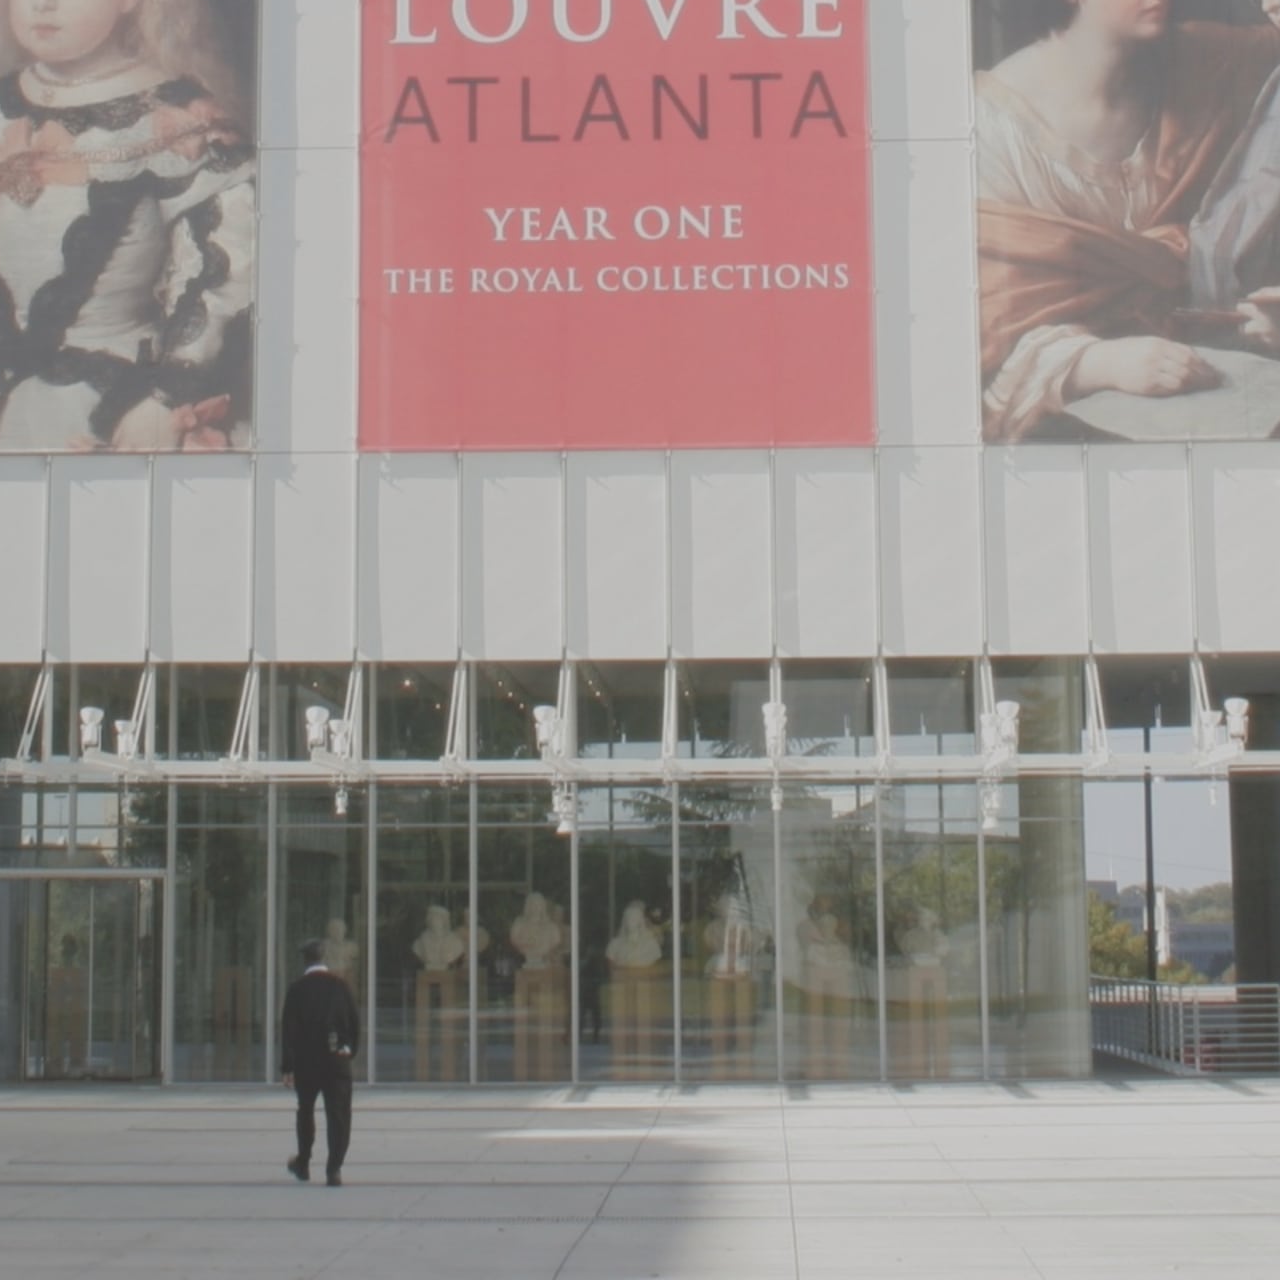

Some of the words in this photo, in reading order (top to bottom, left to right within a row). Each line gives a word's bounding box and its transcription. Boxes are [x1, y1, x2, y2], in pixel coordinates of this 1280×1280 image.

[384, 70, 848, 143] ATLANTA
[484, 206, 616, 241] YEAR
[633, 204, 743, 240] ONE
[383, 268, 454, 294] THE
[471, 267, 583, 293] ROYAL
[596, 263, 849, 292] COLLECTIONS
